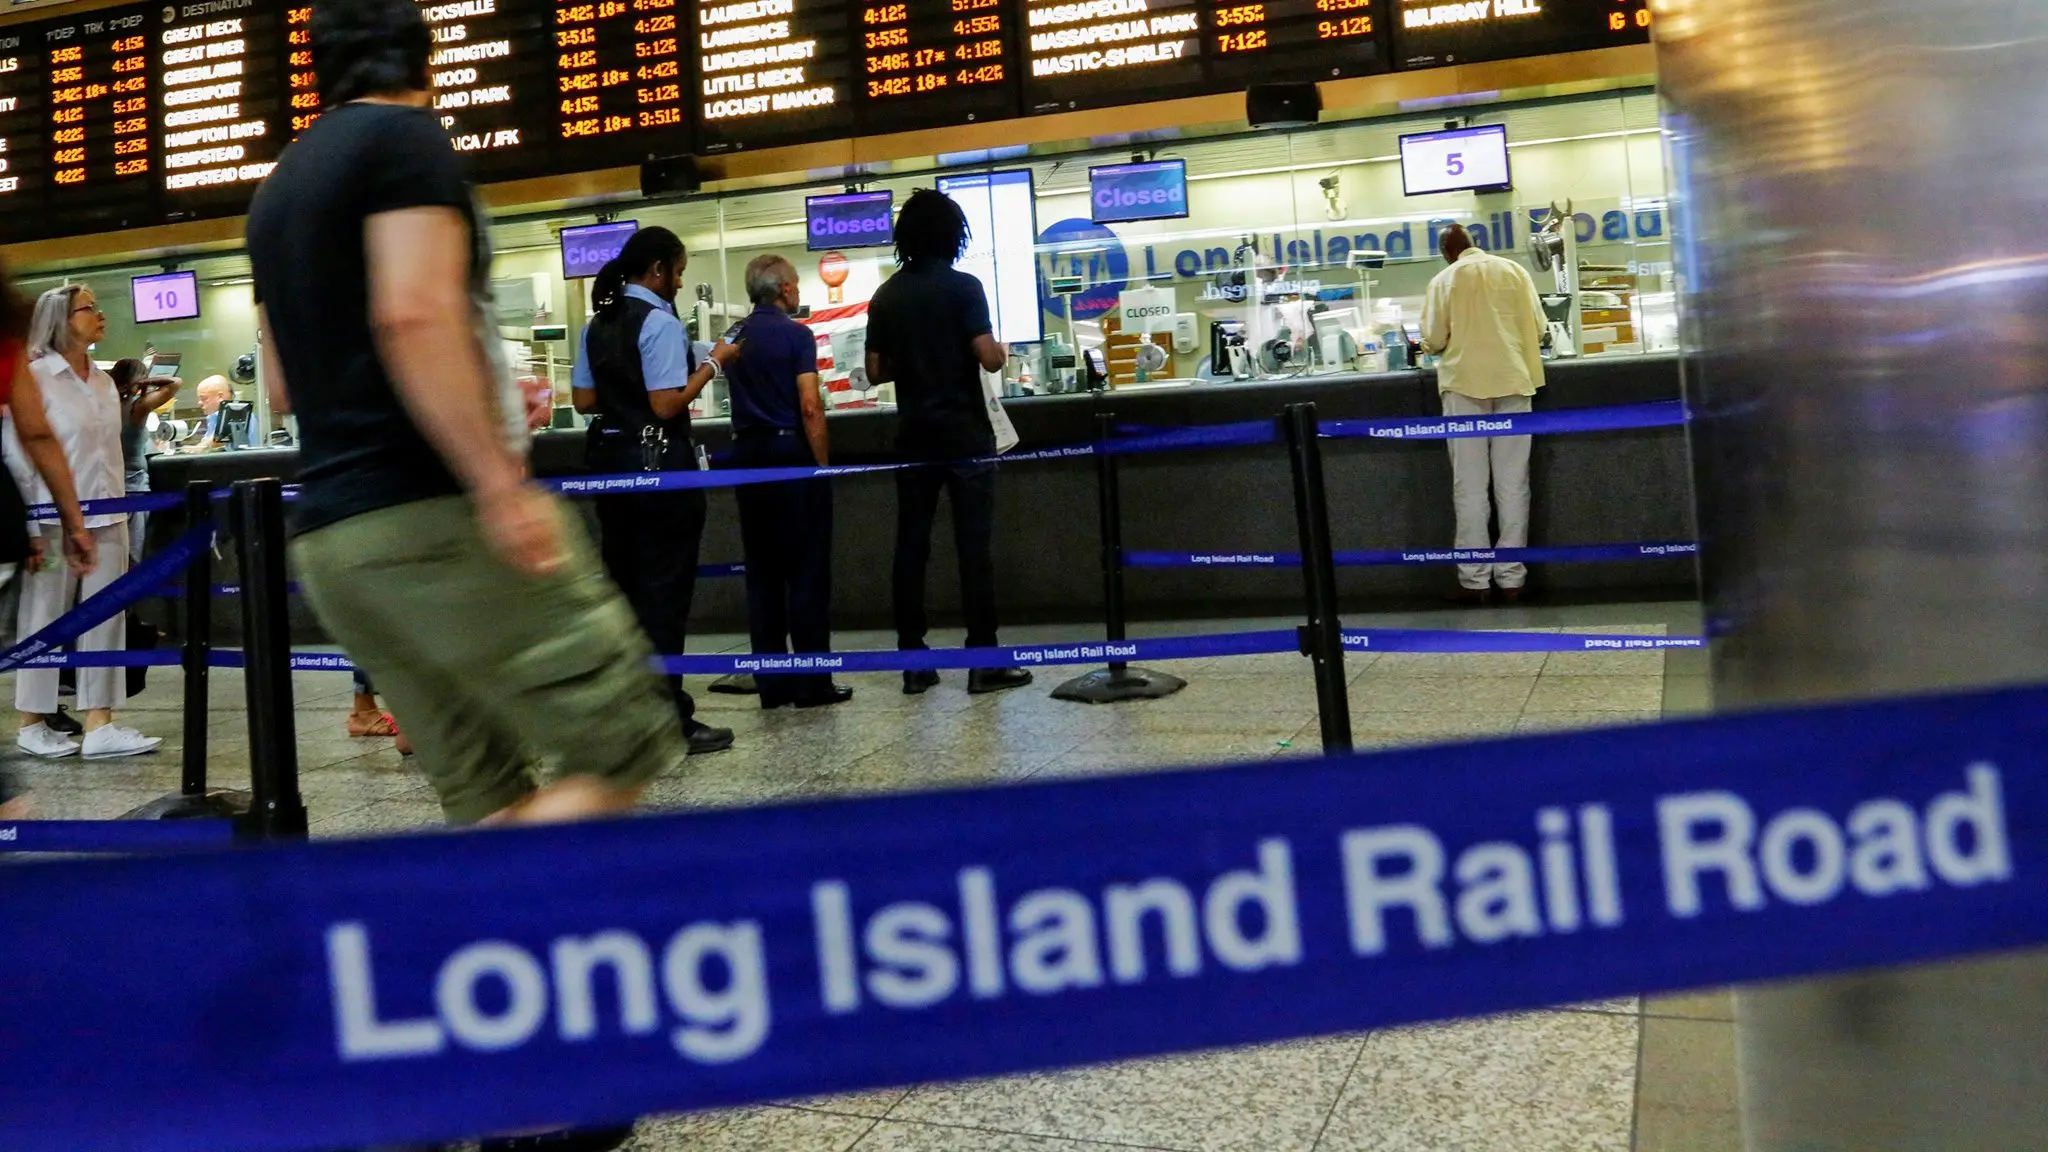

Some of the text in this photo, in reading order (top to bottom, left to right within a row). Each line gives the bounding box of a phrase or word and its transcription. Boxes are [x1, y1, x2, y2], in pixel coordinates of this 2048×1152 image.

[182, 0, 252, 17] DESTINATION
[700, 0, 794, 25] LAURELTON
[1028, 0, 1148, 27] MASSAPEQUA
[1403, 0, 1542, 28] MURRAY HILL
[84, 22, 104, 34] TRK
[162, 25, 204, 44] GREAT
[206, 18, 243, 37] NECK
[701, 20, 790, 49] LAWRENCE
[1031, 19, 1150, 52] MASSAPEQUA
[1150, 12, 1199, 35] PARK
[163, 46, 205, 65] GREAT
[702, 40, 816, 72] LINDENHURST
[1032, 40, 1185, 77] MASTIC-SHIRLEY
[703, 73, 756, 96] LITTLE
[757, 66, 805, 88] NECK
[471, 85, 511, 105] PARK
[704, 86, 835, 119] LOCUST MANOR
[165, 126, 228, 148] HAMPTON
[230, 120, 266, 139] BAYS
[493, 129, 520, 147] JFK
[165, 145, 244, 169] HEMPSTEAD
[1446, 152, 1465, 176] 5
[166, 167, 238, 190] HEMPSTEAD
[1095, 183, 1183, 209] Closed
[811, 212, 891, 236] Closed
[154, 290, 178, 310] 10
[1126, 306, 1170, 318] CLOSED
[1369, 419, 1513, 438] Long Island Rail Road
[1039, 449, 1062, 459] Rail
[1063, 445, 1094, 456] Road
[561, 476, 661, 491] Long Island Rail Road
[1191, 554, 1274, 564] Long Island Rail Road
[1402, 550, 1496, 562] Long Island Rail Road
[1640, 543, 1697, 555] Long Island
[296, 657, 321, 667] Island
[322, 657, 338, 667] Rail
[734, 656, 843, 670] Long Island Rail Road
[1013, 644, 1137, 662] Long Island Rail Road
[324, 760, 2013, 1064] Long Island Rail Road
